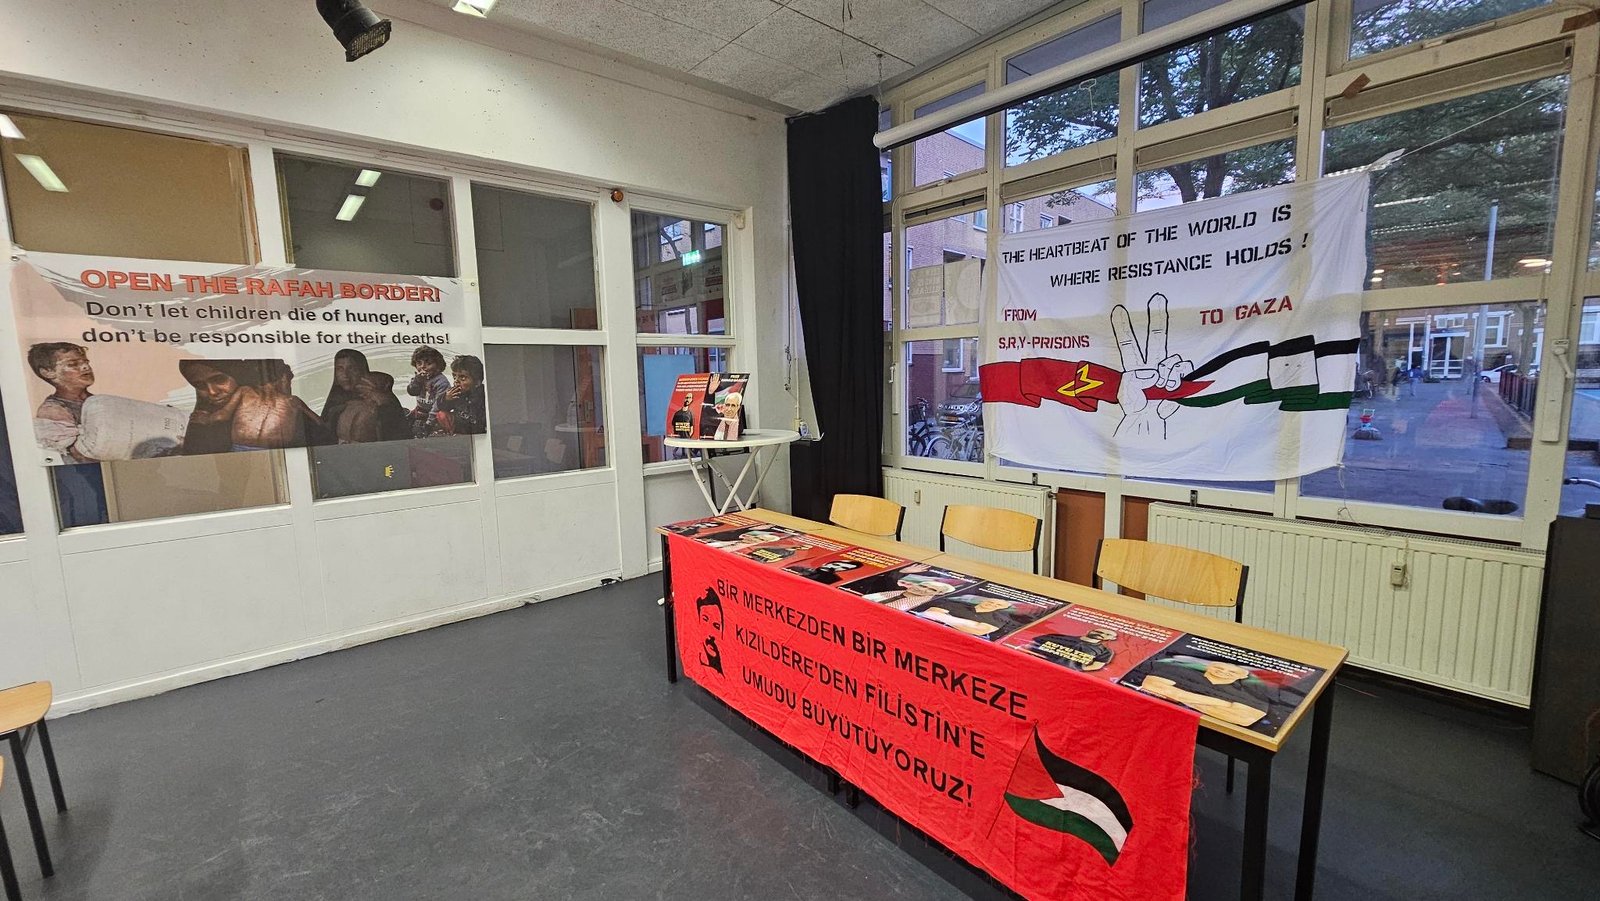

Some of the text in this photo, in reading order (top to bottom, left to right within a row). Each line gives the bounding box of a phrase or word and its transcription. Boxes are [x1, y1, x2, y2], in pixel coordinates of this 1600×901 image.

[1002, 204, 1292, 264] THE HEARTBEAT OF THE WORLD IS
[1050, 269, 1101, 288] WHERE
[1108, 253, 1212, 282] RESISTANCE
[1225, 238, 1292, 266] HOLDS
[80, 269, 441, 302] OPEN THE RAFAH BORDER!
[160, 303, 189, 318] let
[196, 305, 281, 320] children
[288, 307, 316, 321] die
[322, 309, 339, 321] of
[345, 309, 409, 325] hunger,
[414, 312, 443, 324] and
[1004, 308, 1037, 322] FROM
[1199, 295, 1293, 325] TO GAZA
[154, 329, 181, 343] be
[189, 330, 311, 346] responsible
[316, 331, 341, 344] for
[347, 331, 386, 344] their
[391, 332, 450, 344] deaths!
[717, 579, 1028, 720] BİR MERKEZDEN BİR MERKEZE
[735, 624, 857, 698] KIZILDERE'DEN
[742, 665, 972, 807] UMUDU BÜYÜTÜYORUZ!
